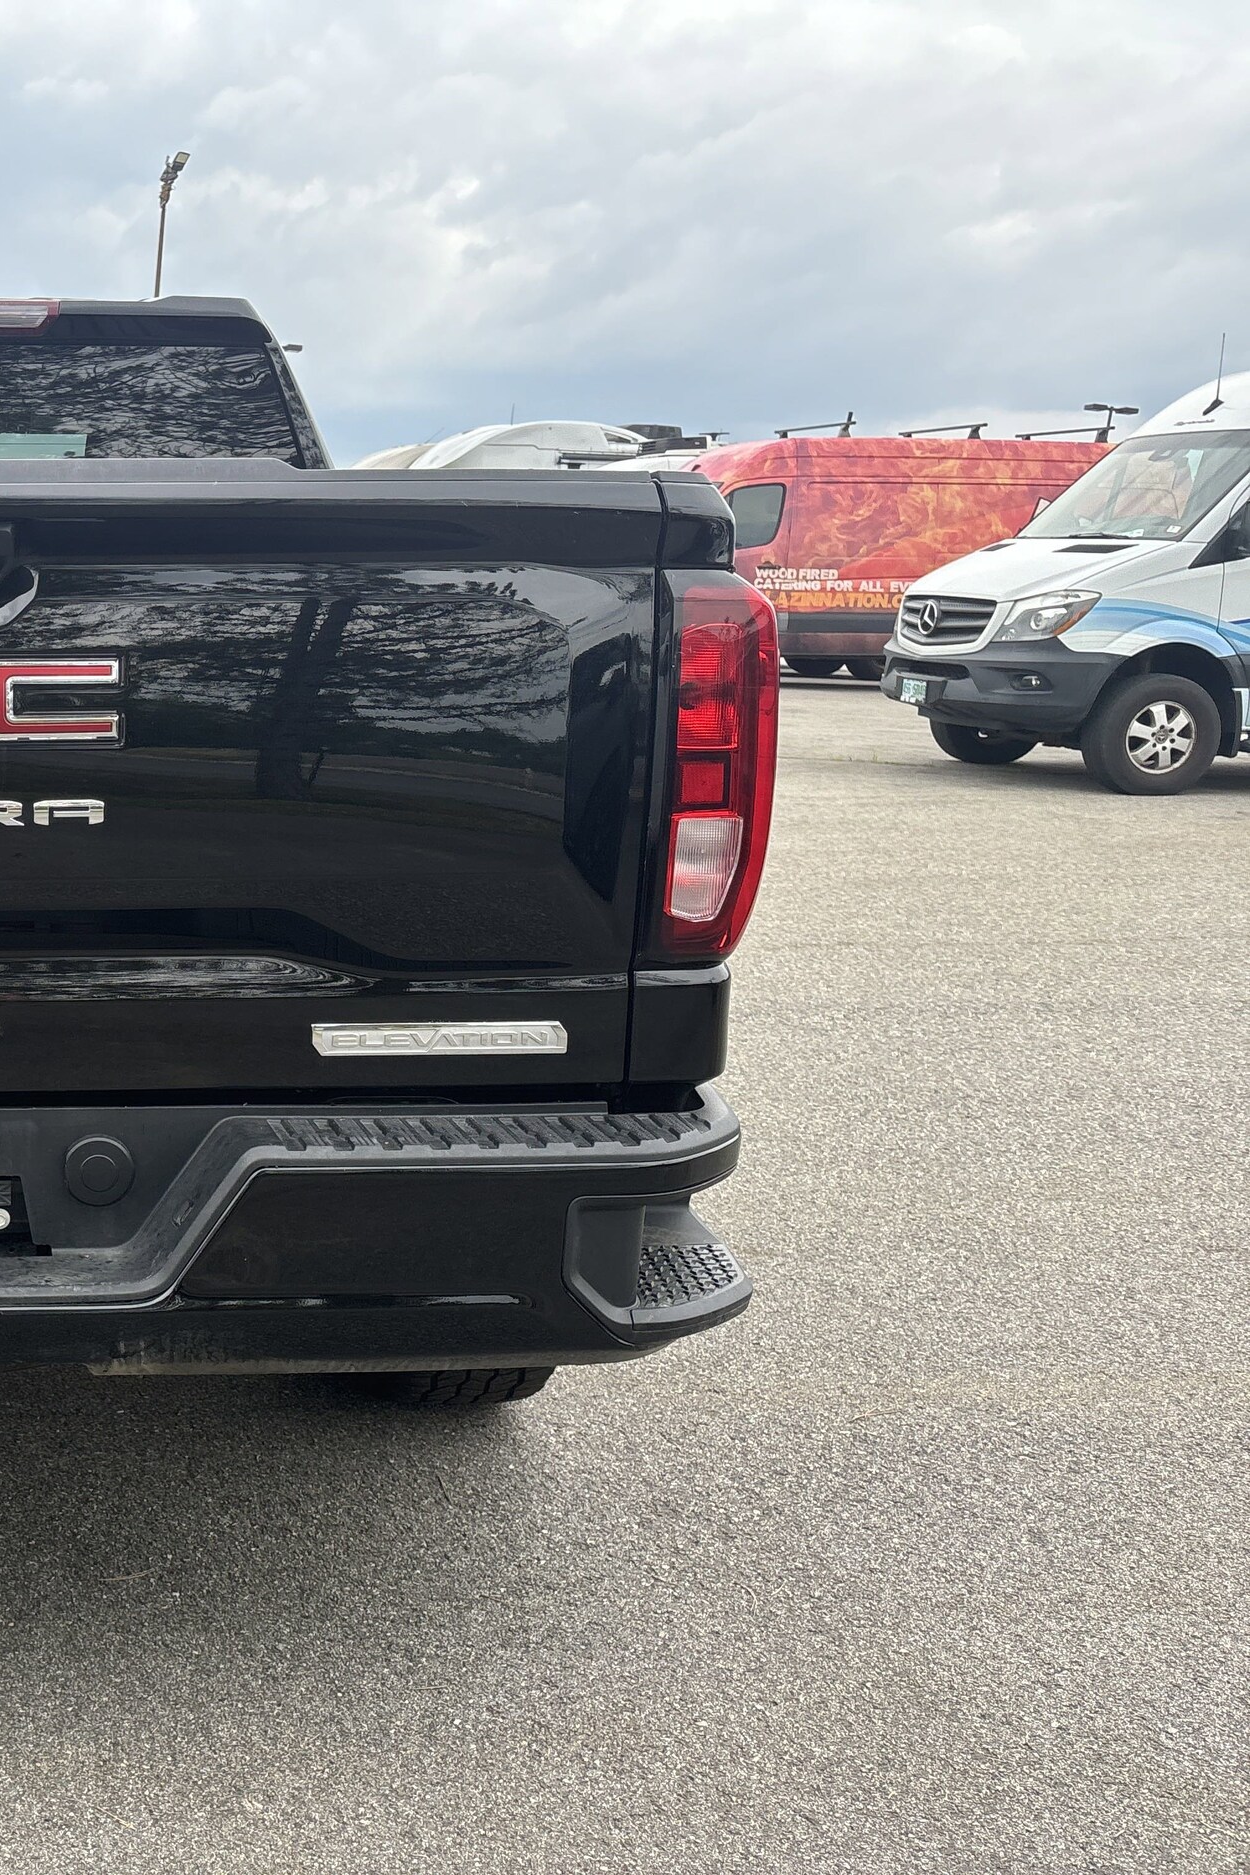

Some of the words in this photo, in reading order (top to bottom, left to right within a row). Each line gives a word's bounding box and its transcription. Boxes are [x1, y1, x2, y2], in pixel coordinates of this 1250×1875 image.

[755, 567, 797, 580] WOOD
[799, 568, 838, 581] FIRED
[753, 578, 821, 592] CATERING
[826, 580, 854, 592] FOR
[859, 580, 884, 593] ALL
[332, 1030, 549, 1049] ELEVATION
